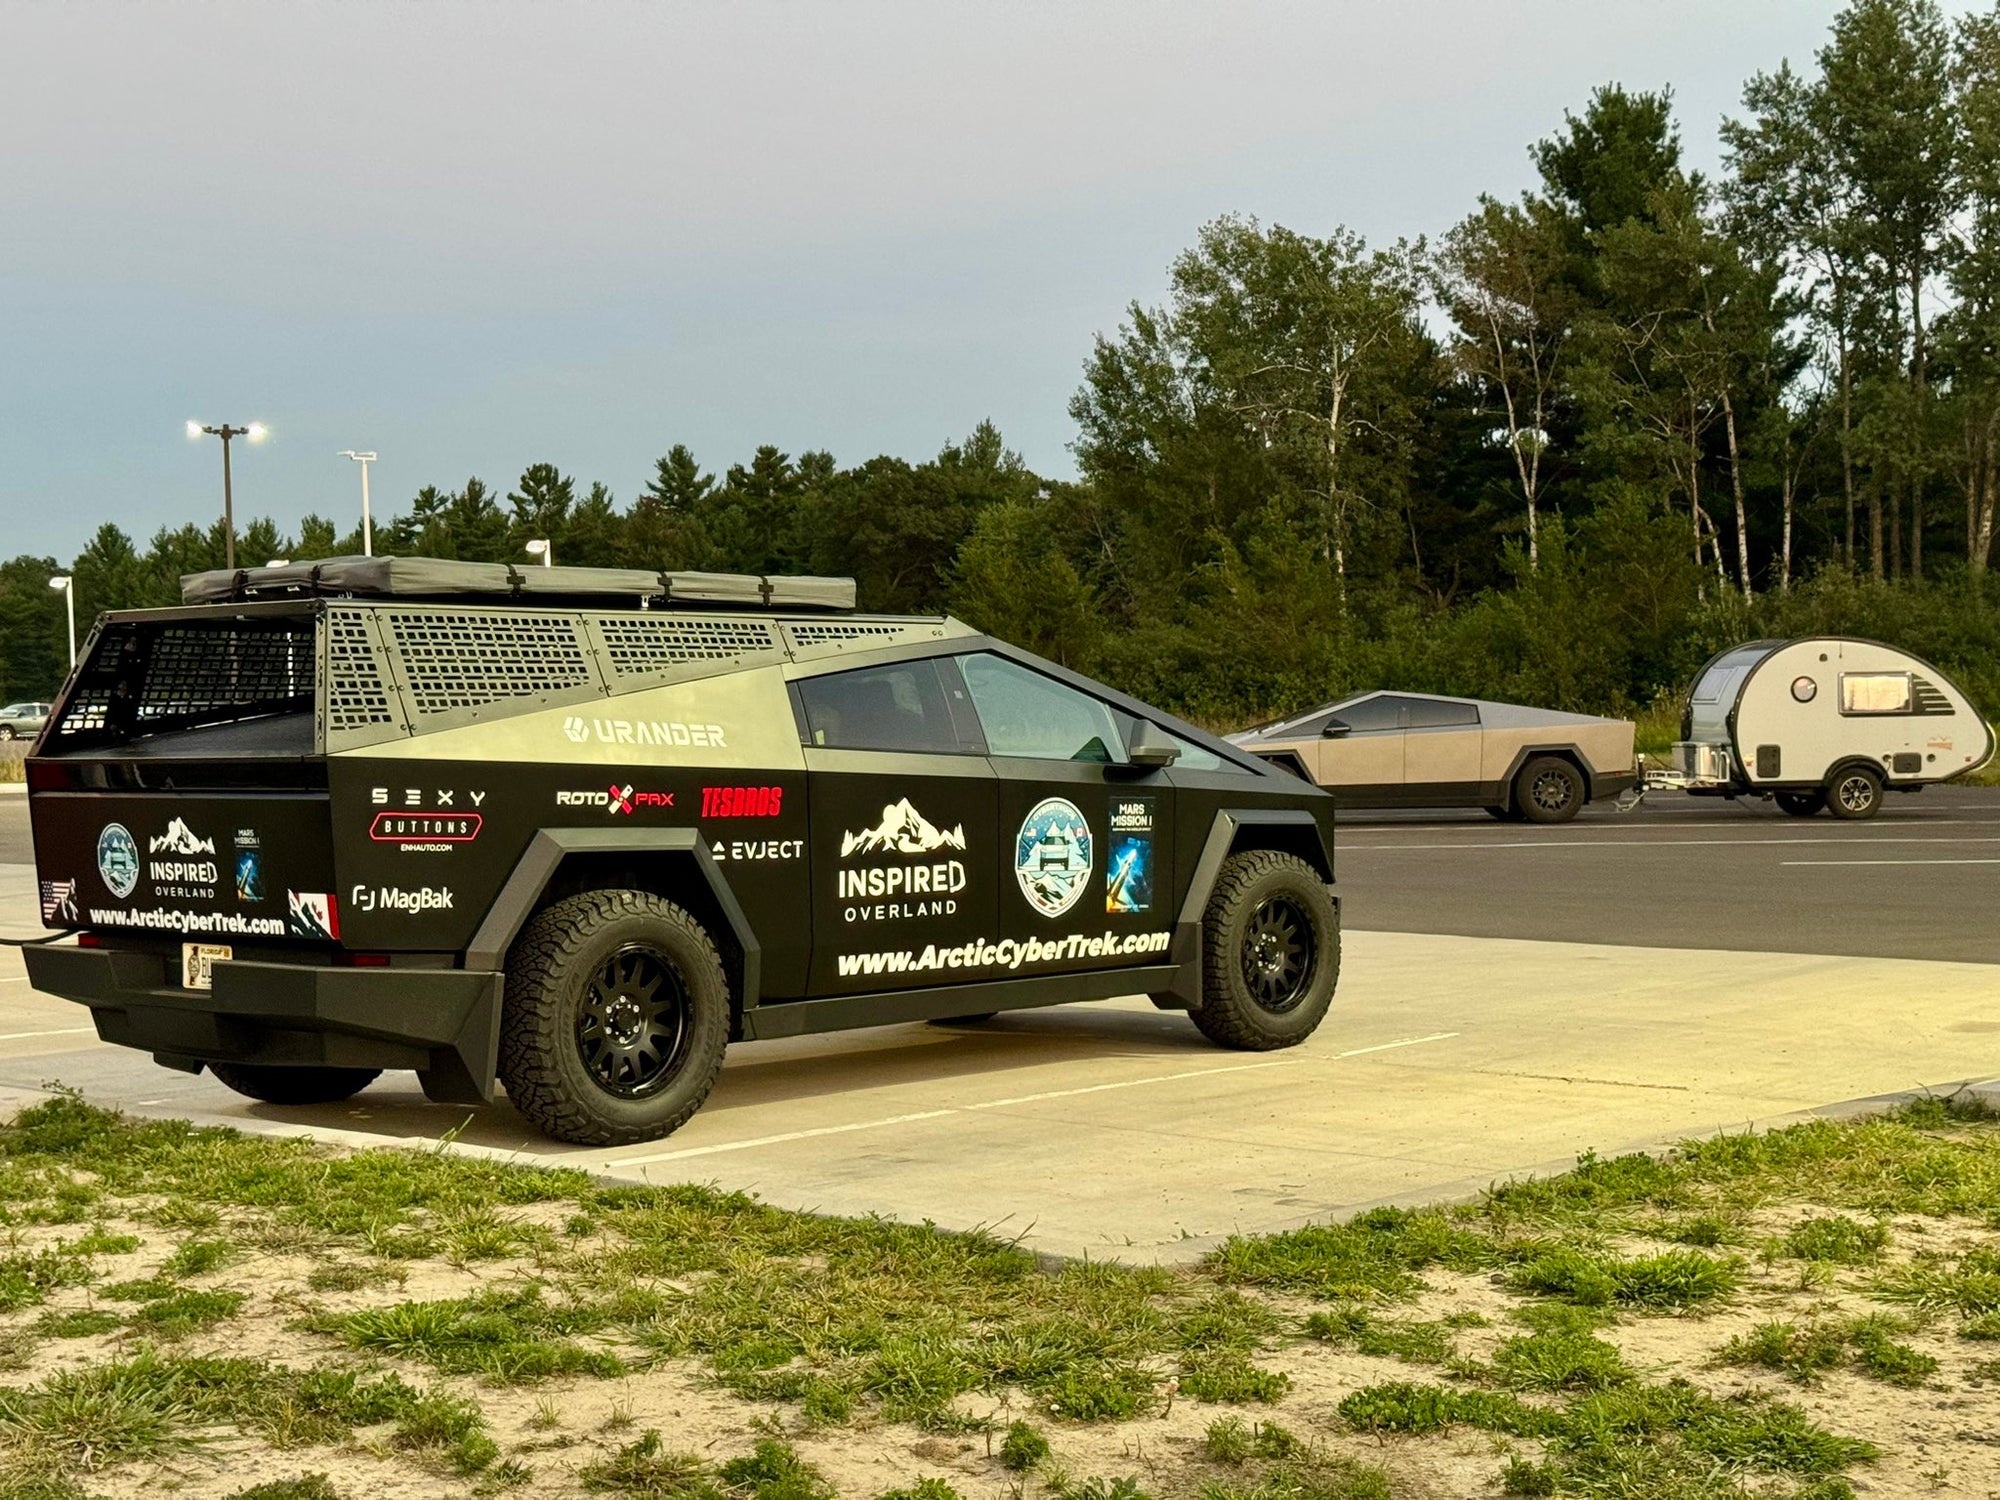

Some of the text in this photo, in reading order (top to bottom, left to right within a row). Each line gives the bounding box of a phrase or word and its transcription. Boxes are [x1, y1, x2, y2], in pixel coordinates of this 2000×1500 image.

[593, 719, 728, 748] URANDER
[371, 787, 486, 807] SEXY
[701, 786, 783, 818] TESBROS
[1110, 814, 1148, 827] MISSION
[1118, 803, 1145, 815] MARS
[384, 820, 468, 834] BUTTONS
[400, 843, 453, 852] ENHAUTO.COM
[731, 840, 804, 860] EVJECT
[149, 861, 218, 884] INSPIRED
[838, 860, 967, 898] INSPIRED
[154, 886, 215, 899] OVERLAND
[380, 886, 454, 914] MagBak
[89, 906, 286, 936] www.ArcticCyberTrek.com
[844, 900, 957, 923] OVERLAND
[838, 930, 1171, 977] www.ArcticCyberTrek.com
